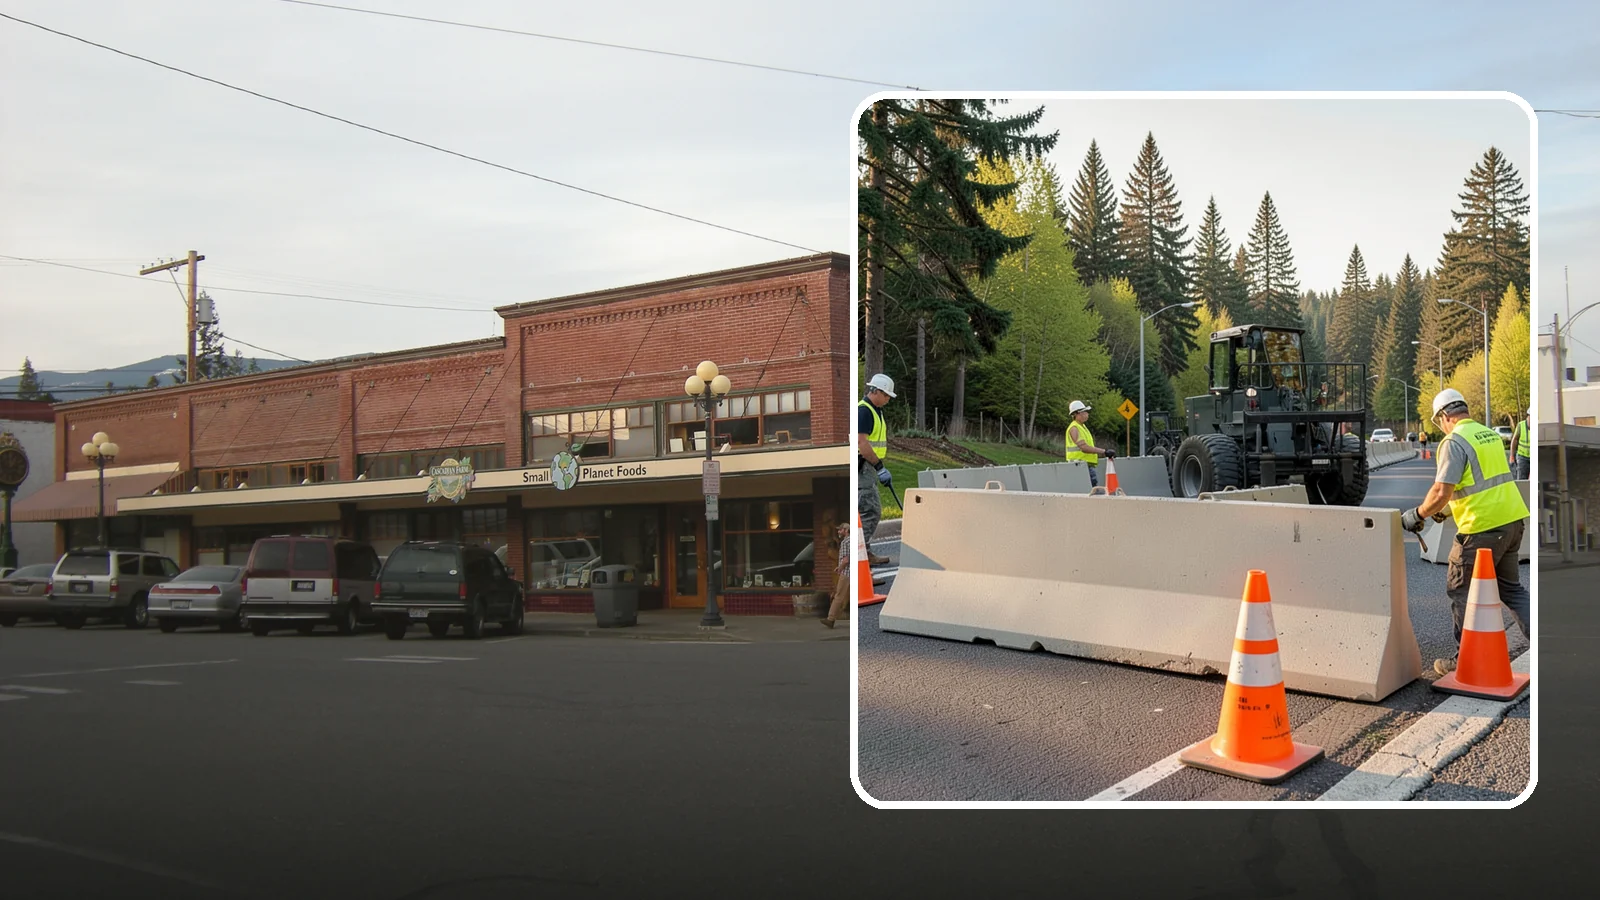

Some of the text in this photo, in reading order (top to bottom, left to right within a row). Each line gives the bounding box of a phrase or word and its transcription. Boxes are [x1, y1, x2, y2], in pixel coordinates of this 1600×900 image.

[523, 464, 647, 482] Small Planet Foods
